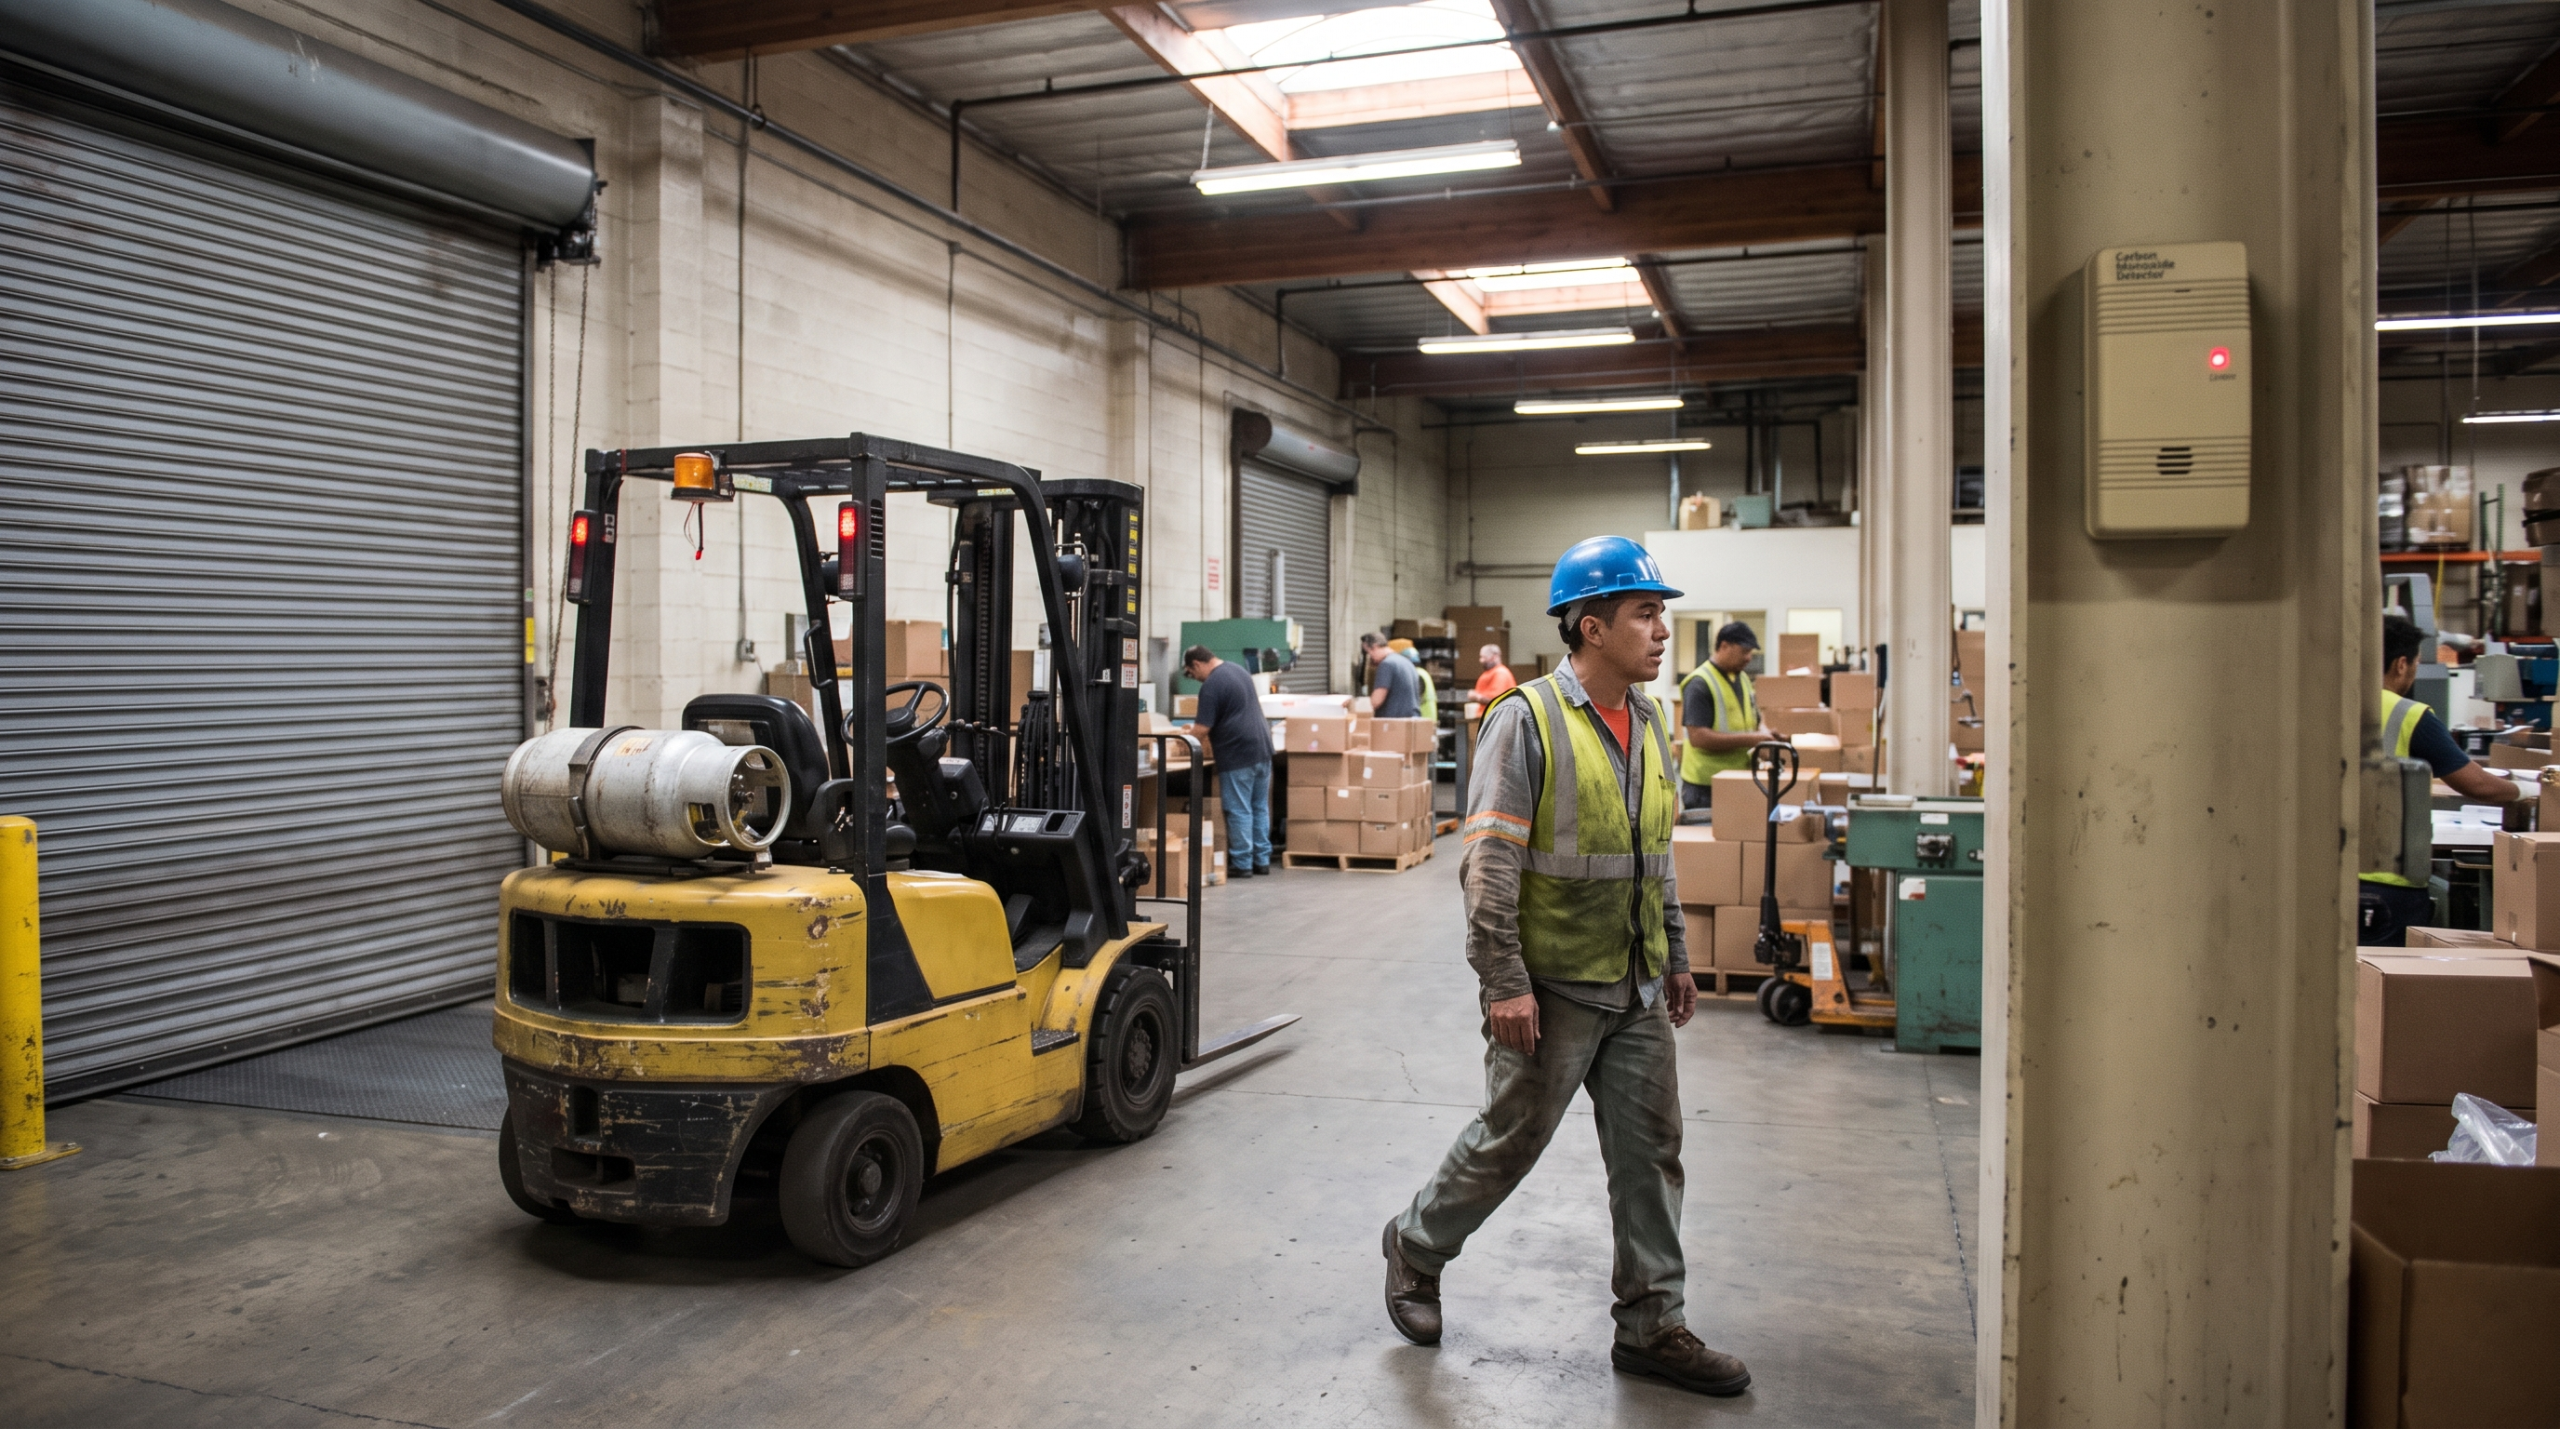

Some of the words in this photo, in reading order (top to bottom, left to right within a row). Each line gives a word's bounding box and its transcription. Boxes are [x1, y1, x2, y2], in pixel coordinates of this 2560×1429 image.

[2115, 251, 2157, 261] Carbon
[2116, 260, 2174, 270] Monoxide
[2116, 270, 2164, 280] Detector
